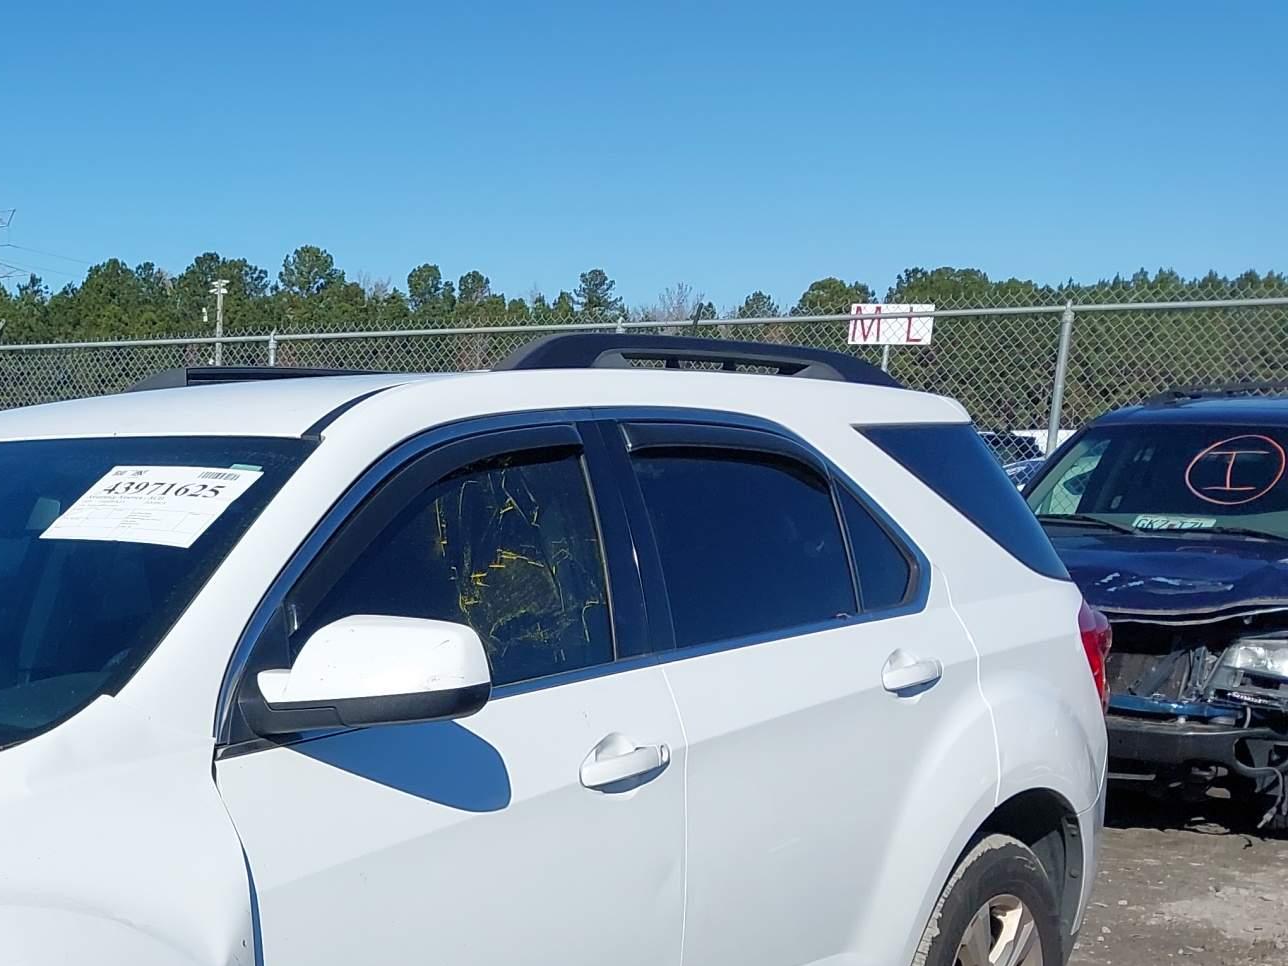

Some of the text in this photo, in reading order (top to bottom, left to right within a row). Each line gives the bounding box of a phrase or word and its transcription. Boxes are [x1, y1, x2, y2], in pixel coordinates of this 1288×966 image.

[851, 306, 922, 342] M L
[101, 481, 227, 499] 43971625
